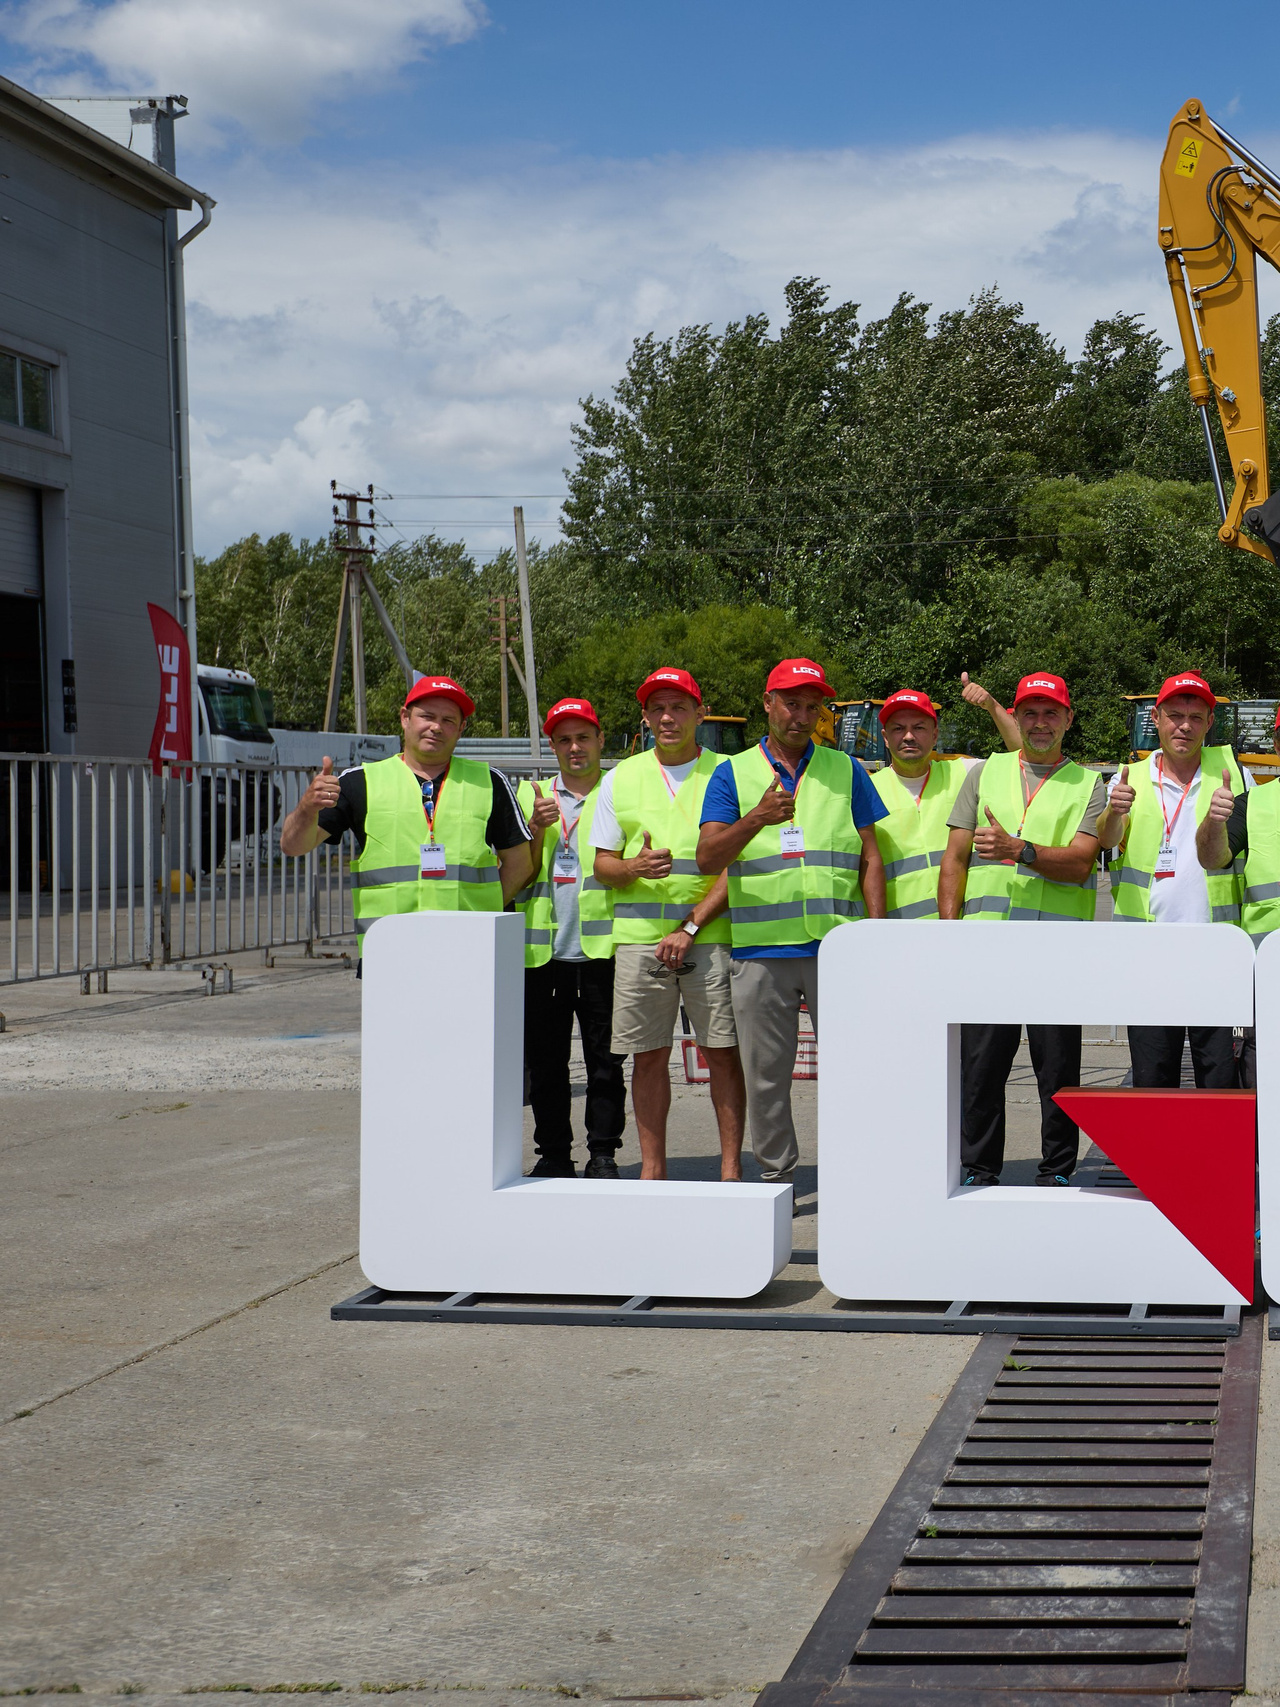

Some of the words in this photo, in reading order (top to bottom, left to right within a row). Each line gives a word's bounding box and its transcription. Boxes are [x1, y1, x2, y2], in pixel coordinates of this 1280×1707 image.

[651, 673, 680, 681] GCE
[793, 667, 821, 678] LGCE
[432, 682, 458, 691] LG
[1027, 680, 1055, 690] LGCE
[553, 703, 581, 714] LGCE
